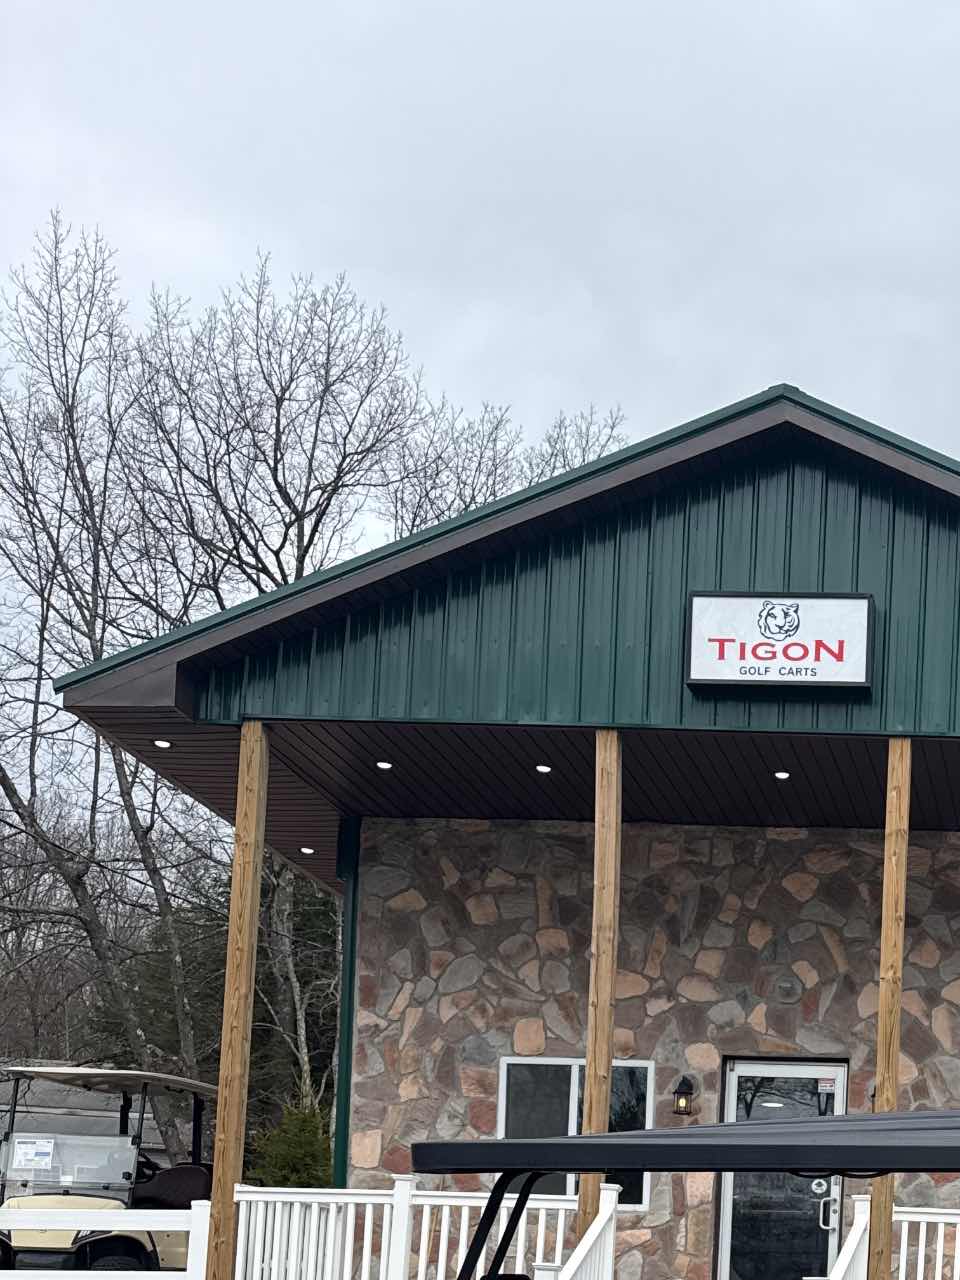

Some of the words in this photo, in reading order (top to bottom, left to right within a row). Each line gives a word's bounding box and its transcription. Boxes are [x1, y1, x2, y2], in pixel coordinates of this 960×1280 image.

[707, 638, 845, 662] TIGON
[739, 666, 771, 676] GOLF
[778, 667, 817, 677] CARTS
